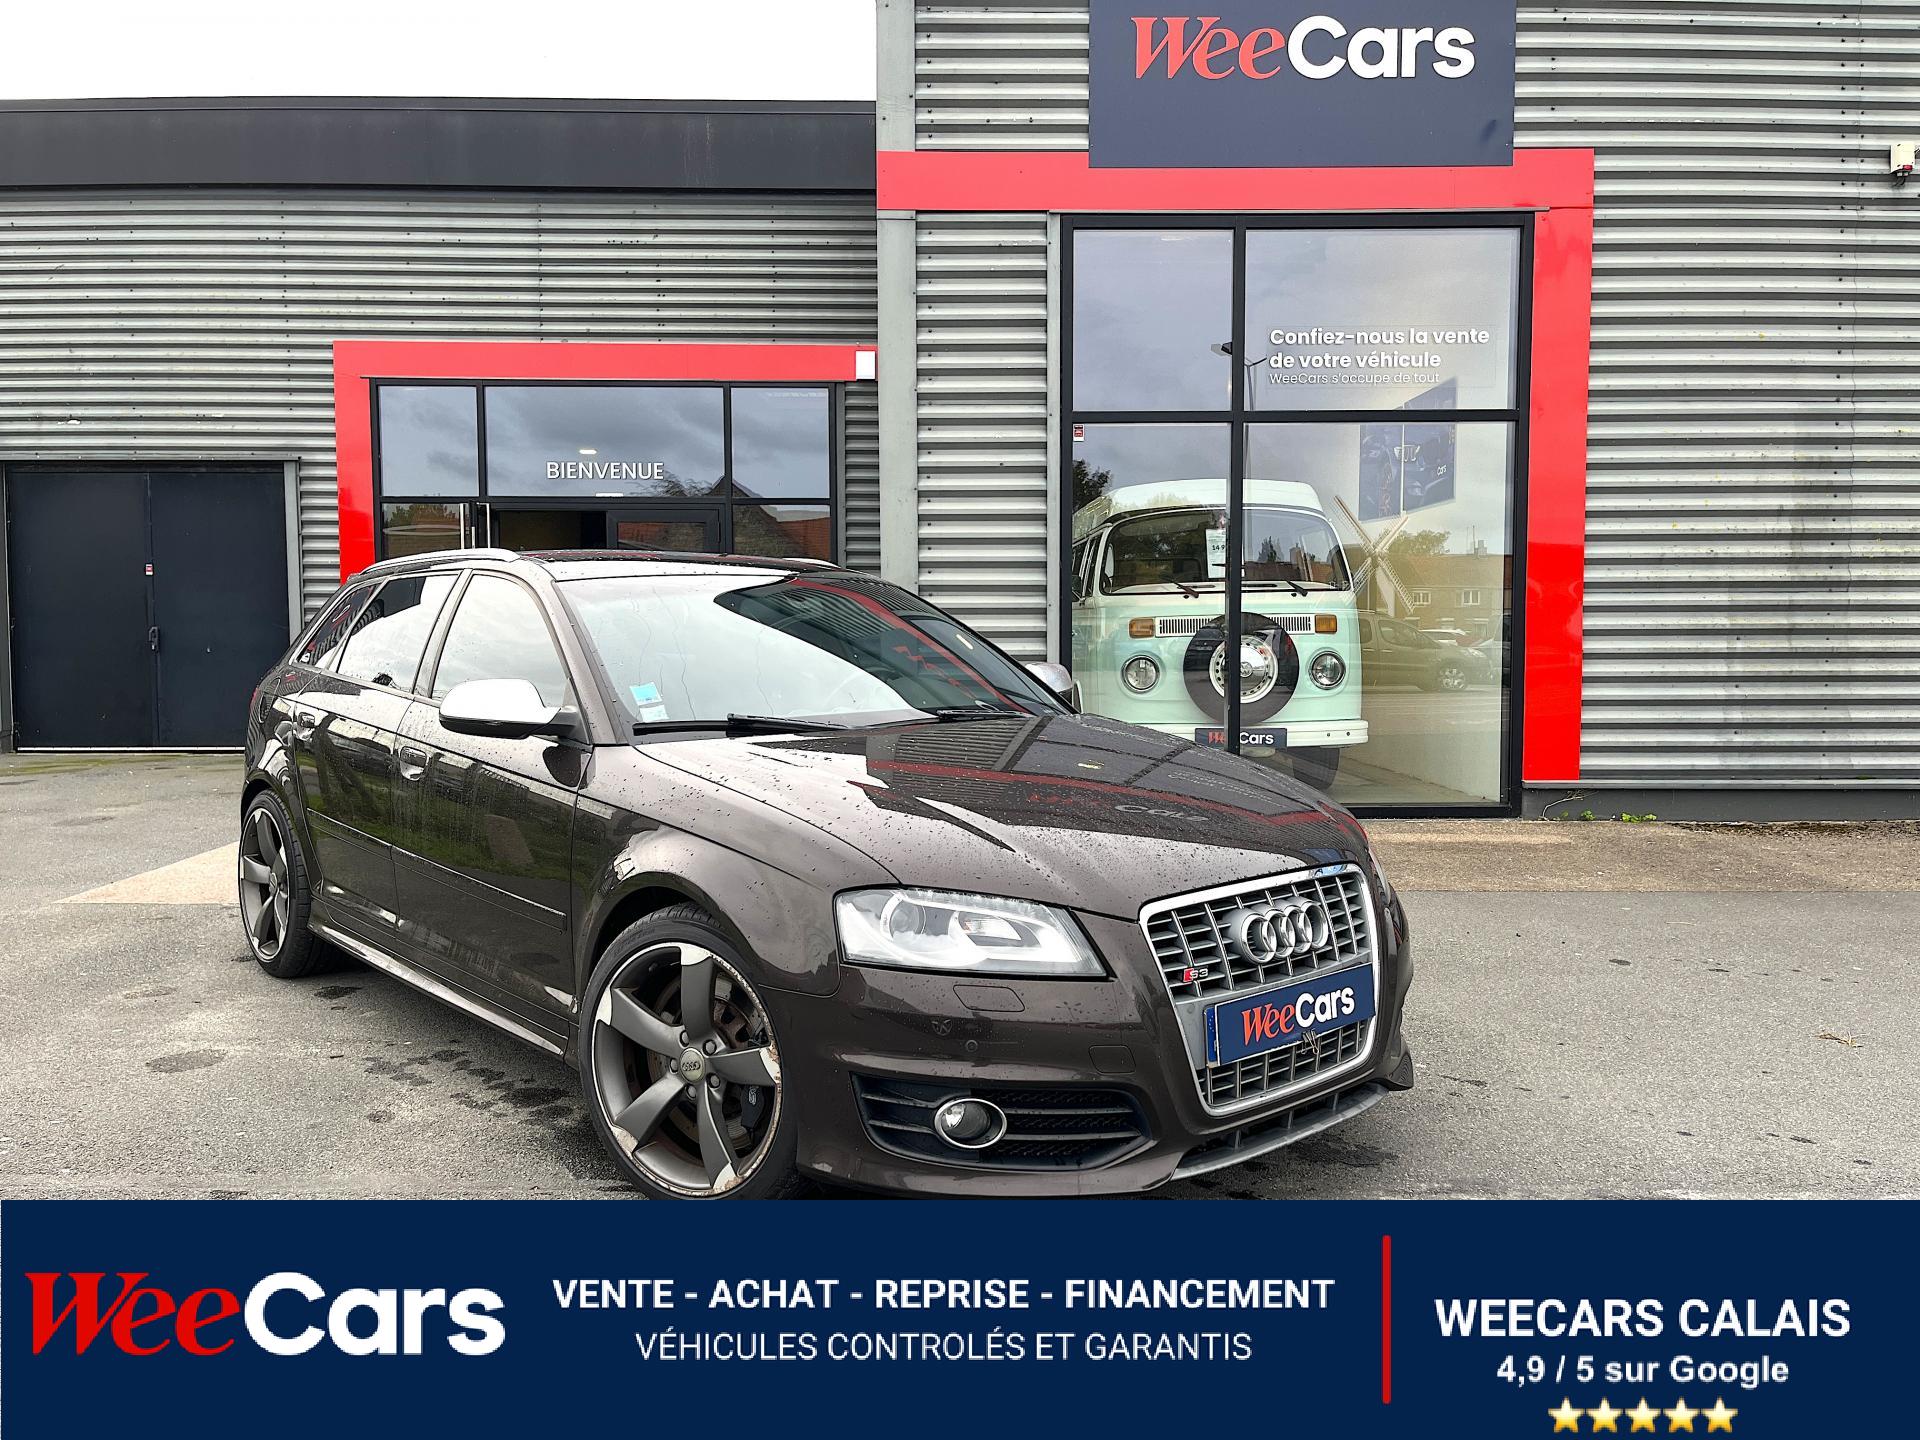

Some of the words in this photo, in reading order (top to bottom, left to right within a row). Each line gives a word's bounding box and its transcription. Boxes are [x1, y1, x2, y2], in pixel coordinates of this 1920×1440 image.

[1131, 15, 1476, 79] WeeCars
[1270, 327, 1405, 345] Confiez-nous
[1409, 327, 1428, 344] la
[1432, 329, 1490, 344] vente
[1269, 352, 1295, 368] de
[1299, 354, 1352, 368] votre
[1356, 351, 1442, 368] véhicule
[1270, 373, 1328, 384] WeeCars
[1394, 372, 1411, 383] de
[1413, 373, 1440, 383] tout
[546, 461, 664, 480] BIENVENUE
[1242, 987, 1355, 1046] WeeCars
